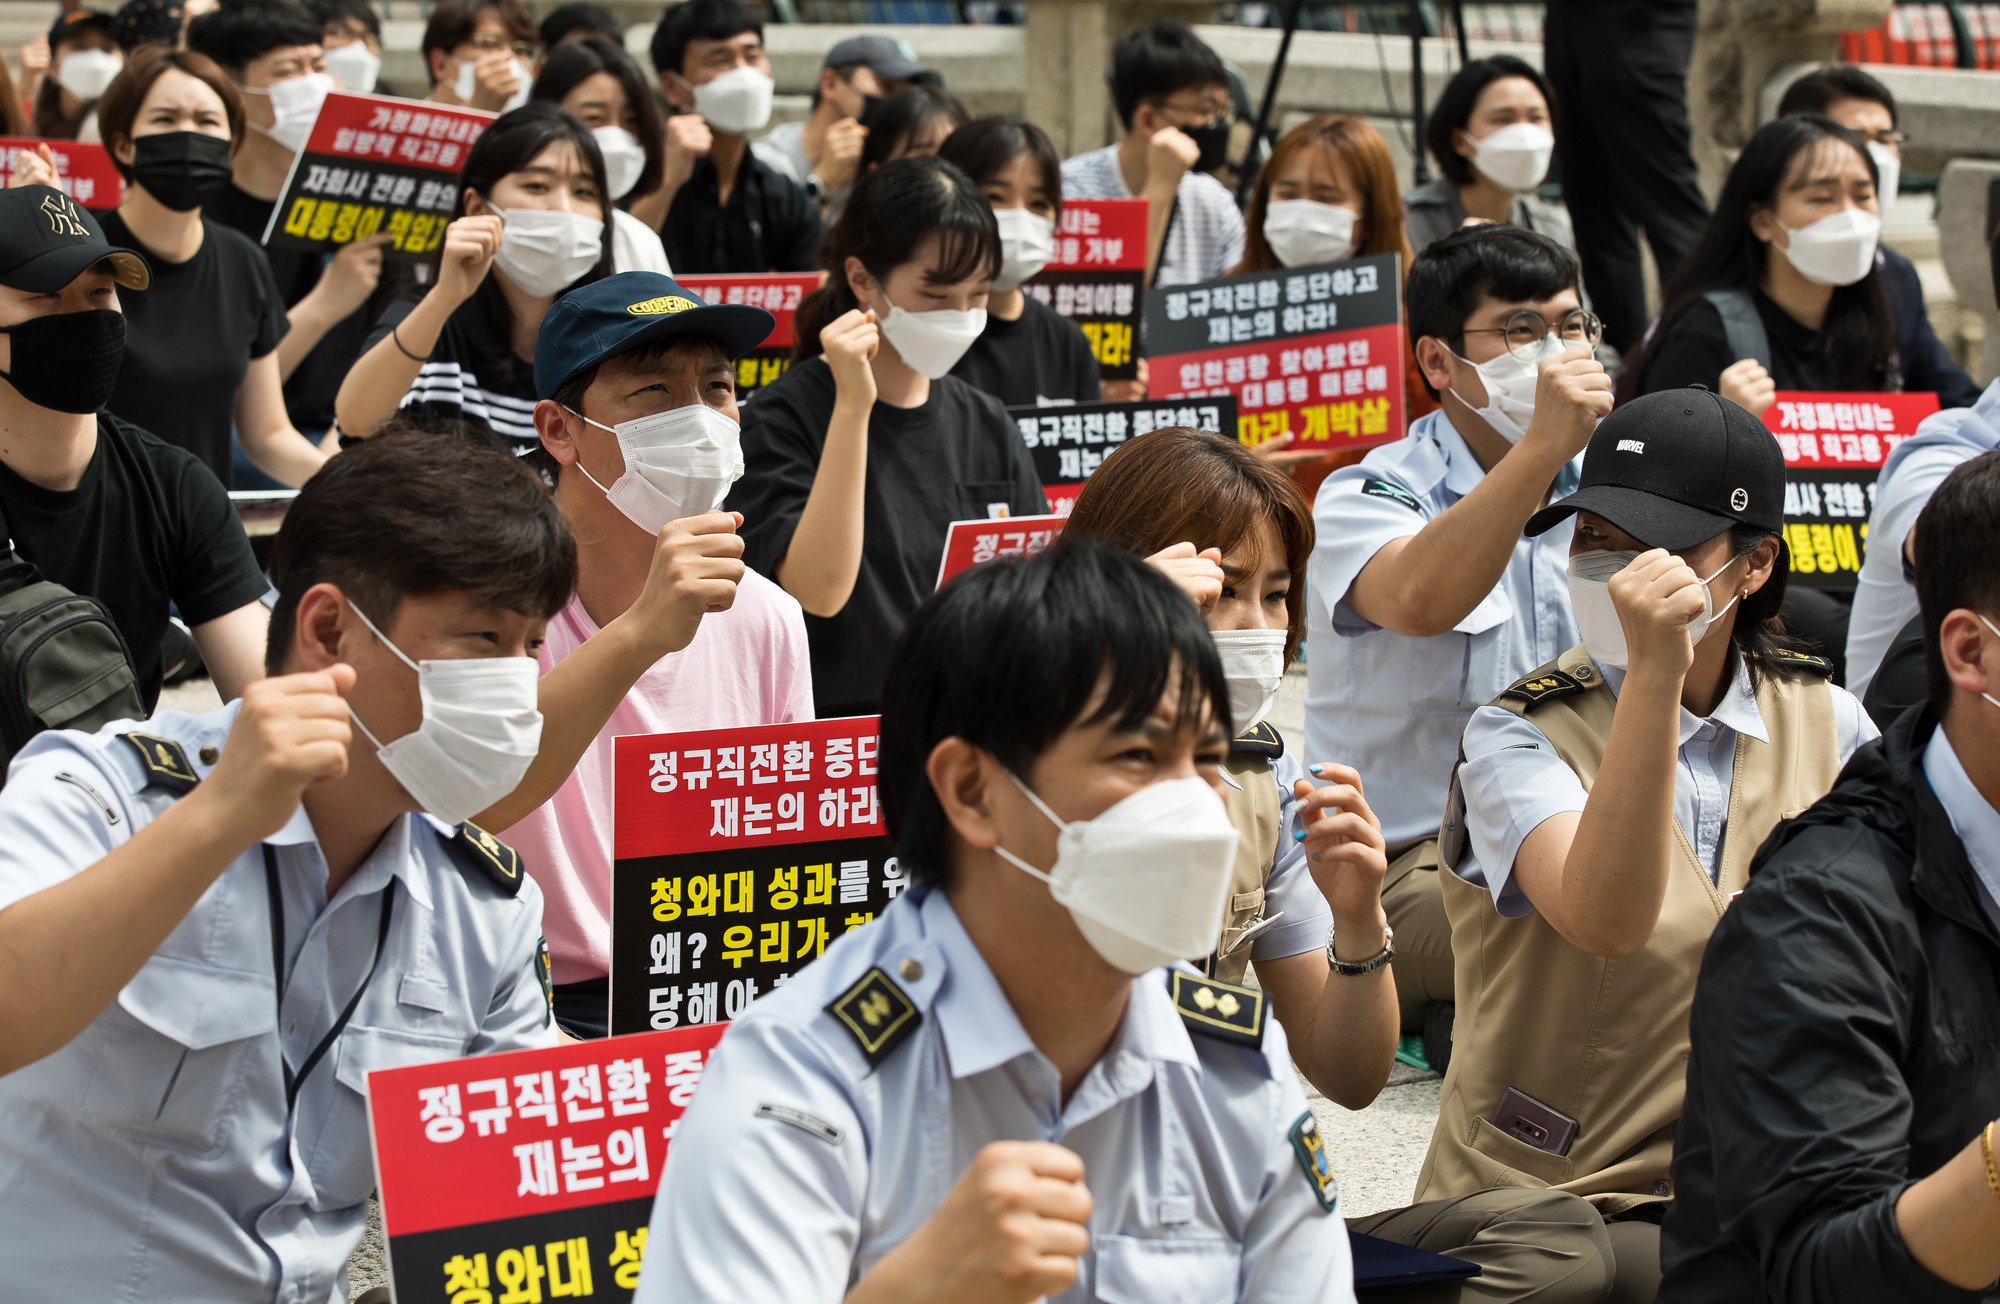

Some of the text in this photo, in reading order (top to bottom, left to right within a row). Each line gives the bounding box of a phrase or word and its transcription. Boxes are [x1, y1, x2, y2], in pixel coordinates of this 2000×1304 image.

[301, 164, 370, 199] 자회사
[40, 194, 90, 236] NY
[283, 196, 386, 244] 대통령이
[1084, 237, 1123, 264] 거부
[1055, 283, 1135, 317] 합의이행
[1165, 265, 1380, 322] 정규직전환 중단하고
[1207, 303, 1338, 344] 재논의 하라!
[1179, 354, 1269, 390] 인천공항
[1241, 365, 1388, 409] 대통령 때문에
[1017, 411, 1129, 449] 정규직전환
[1300, 396, 1392, 442] 개박살
[1776, 401, 1896, 432] 가정파탄내는
[1616, 439, 1645, 454] MARVEL
[1772, 432, 1821, 463] 방적
[1820, 433, 1883, 463] 직고용
[1821, 482, 1866, 517] 전환
[648, 740, 814, 793] 정규직전환
[710, 791, 805, 838] 재논의
[650, 870, 755, 923] 청와대
[767, 859, 870, 911] 성과를
[649, 931, 708, 975] 왜?
[721, 917, 830, 969] 우리가
[649, 977, 759, 1031] 당해야
[418, 1057, 652, 1143] 정규직전환
[512, 1126, 651, 1199] 재논의
[443, 1236, 595, 1304] 청와대
